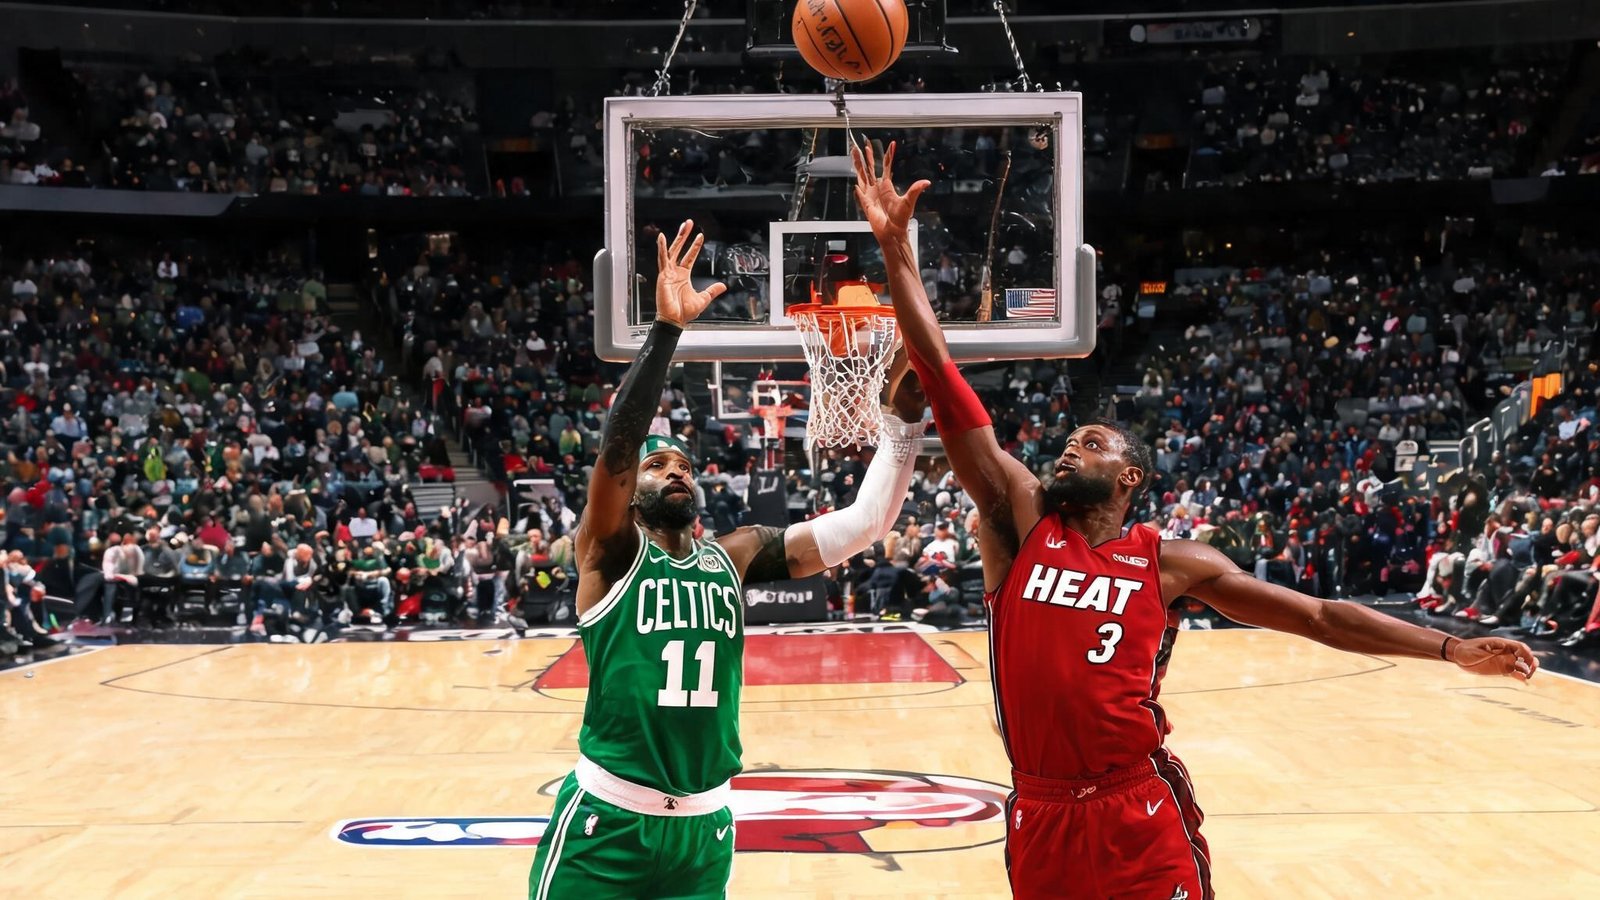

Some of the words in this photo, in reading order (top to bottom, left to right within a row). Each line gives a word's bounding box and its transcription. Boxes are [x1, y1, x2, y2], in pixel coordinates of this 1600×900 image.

[636, 577, 737, 639] CELTICS
[1022, 563, 1143, 615] HEAT
[1086, 621, 1123, 664] 3
[657, 640, 719, 707] 11
